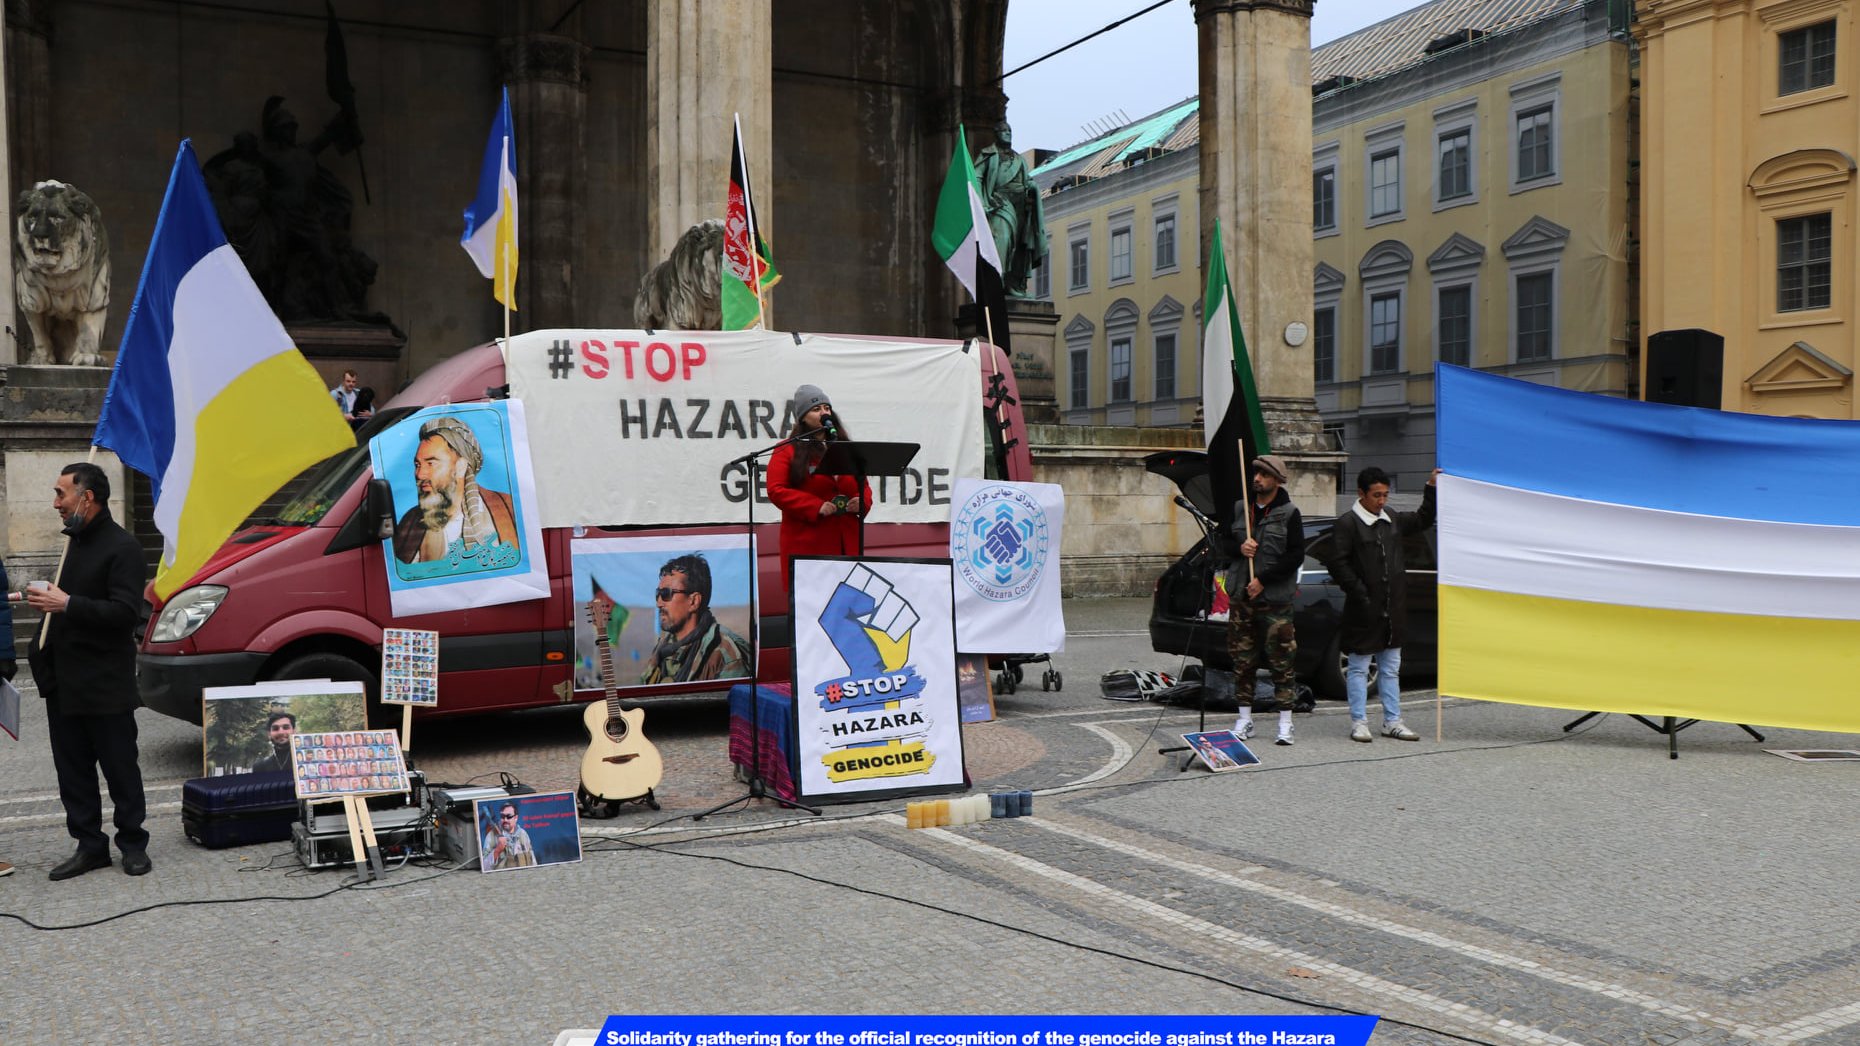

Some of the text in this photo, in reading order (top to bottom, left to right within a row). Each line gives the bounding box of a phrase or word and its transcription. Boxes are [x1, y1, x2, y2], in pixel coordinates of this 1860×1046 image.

[548, 339, 707, 382] #STOP
[720, 462, 951, 506] GEIDE
[963, 566, 1040, 599] World Hazara Council
[825, 673, 907, 703] #STOP
[832, 711, 924, 737] HAZARA
[833, 750, 925, 774] GENOCIDE
